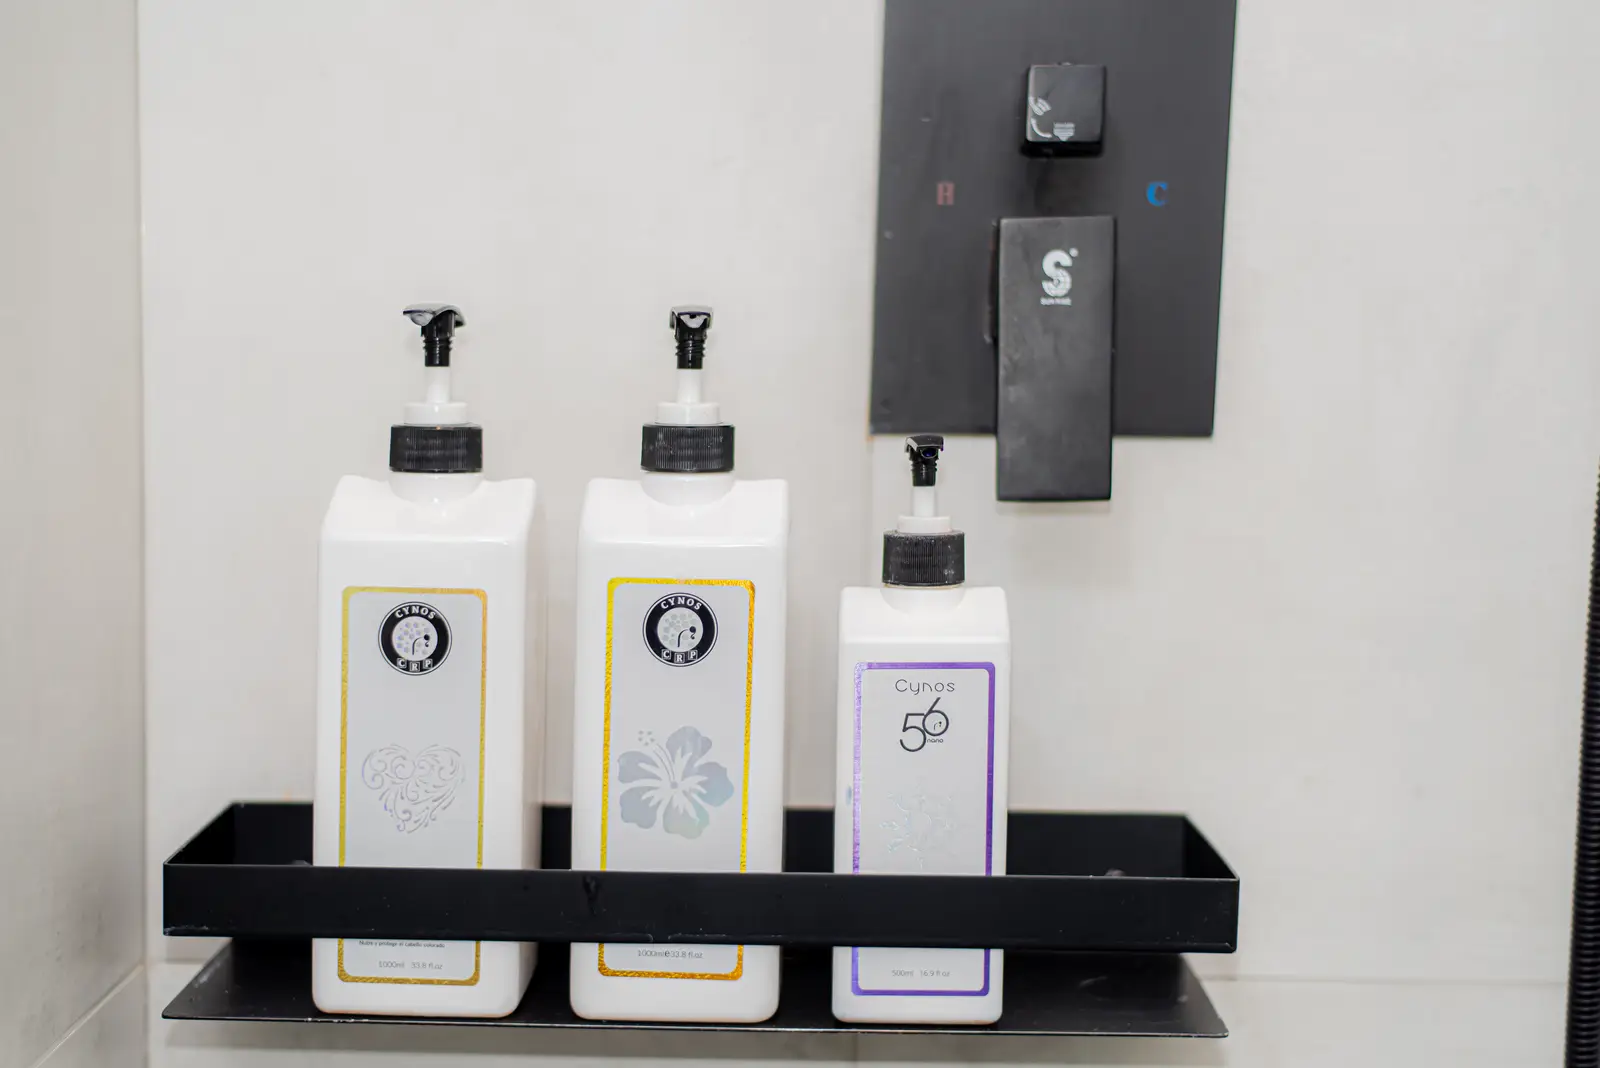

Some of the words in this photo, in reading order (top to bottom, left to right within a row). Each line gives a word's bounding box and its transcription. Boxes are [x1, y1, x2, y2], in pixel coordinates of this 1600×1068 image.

[936, 181, 955, 205] H
[1146, 181, 1169, 207] C
[660, 596, 702, 610] CYNOS
[395, 605, 436, 619] CYNOS
[895, 679, 955, 695] Cynos
[378, 960, 405, 969] 1000ml
